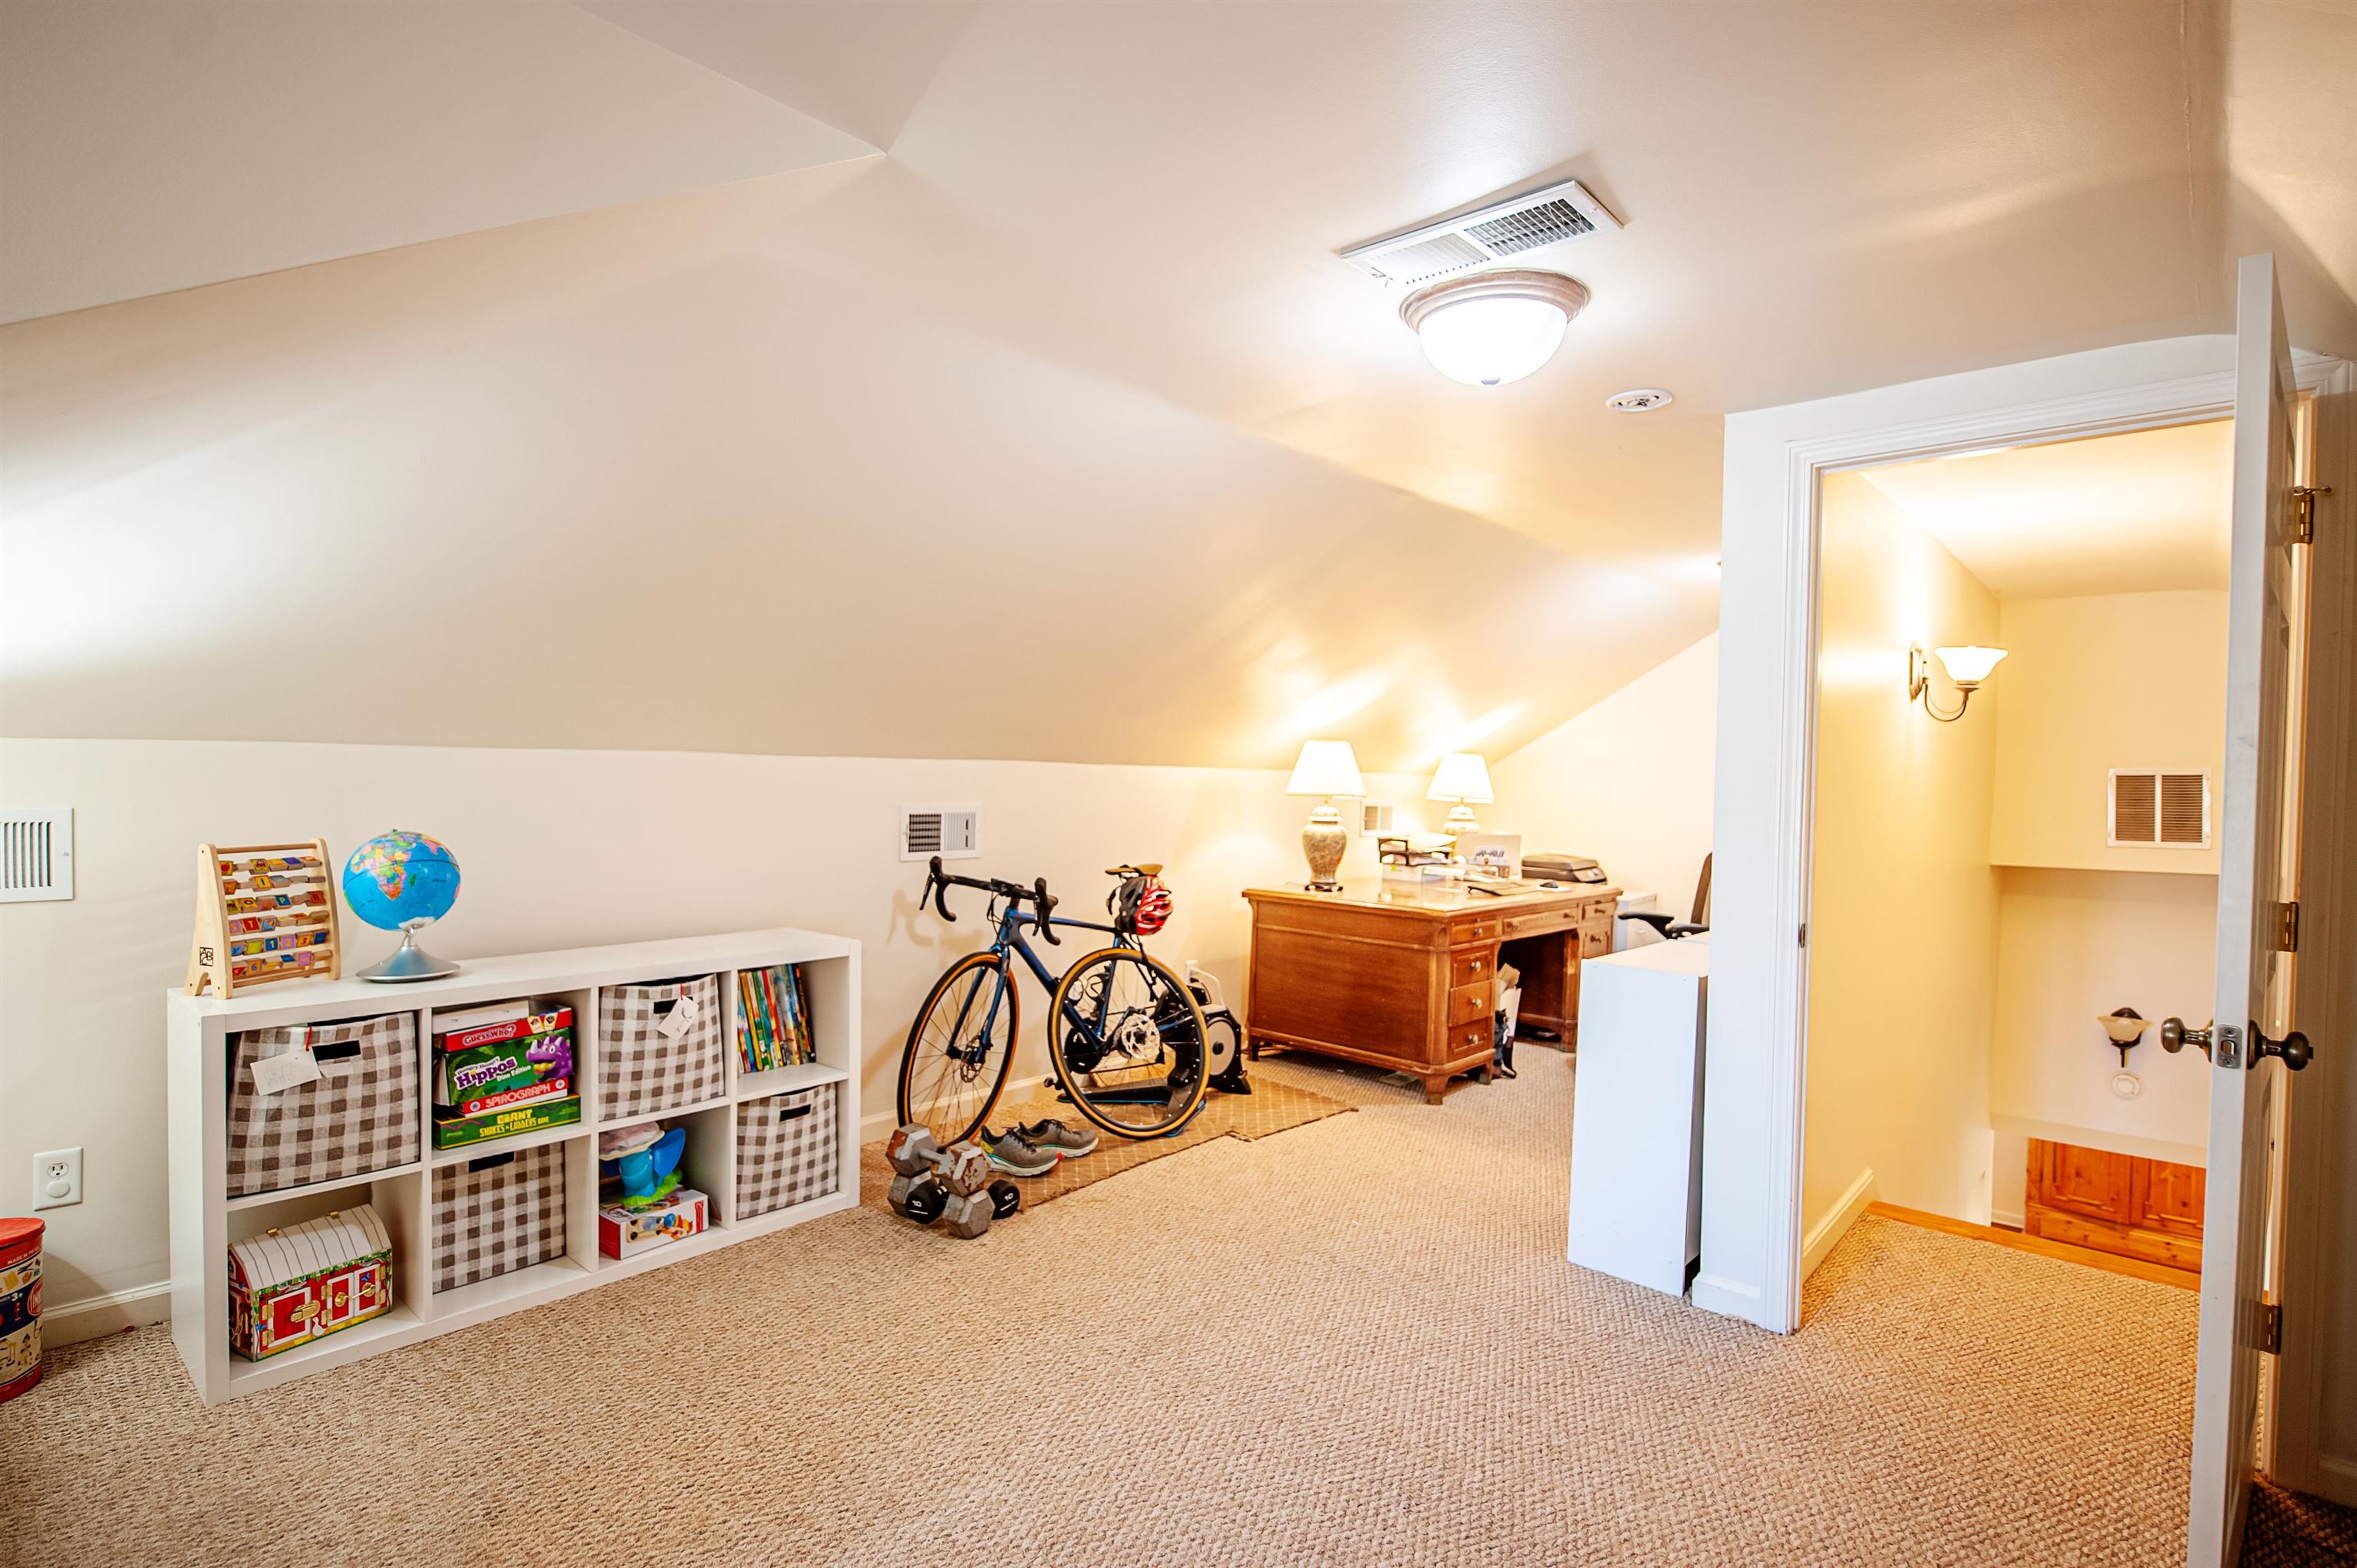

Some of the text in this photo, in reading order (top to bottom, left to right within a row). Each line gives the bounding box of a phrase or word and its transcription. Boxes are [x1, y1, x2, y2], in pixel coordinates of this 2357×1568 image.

[247, 920, 255, 928] T
[456, 1059, 516, 1089] Hippos
[485, 1082, 551, 1108] SPIROGRAPH
[509, 1116, 537, 1131] LADDERS
[8, 1255, 22, 1265] MADE
[12, 1292, 23, 1301] 3+
